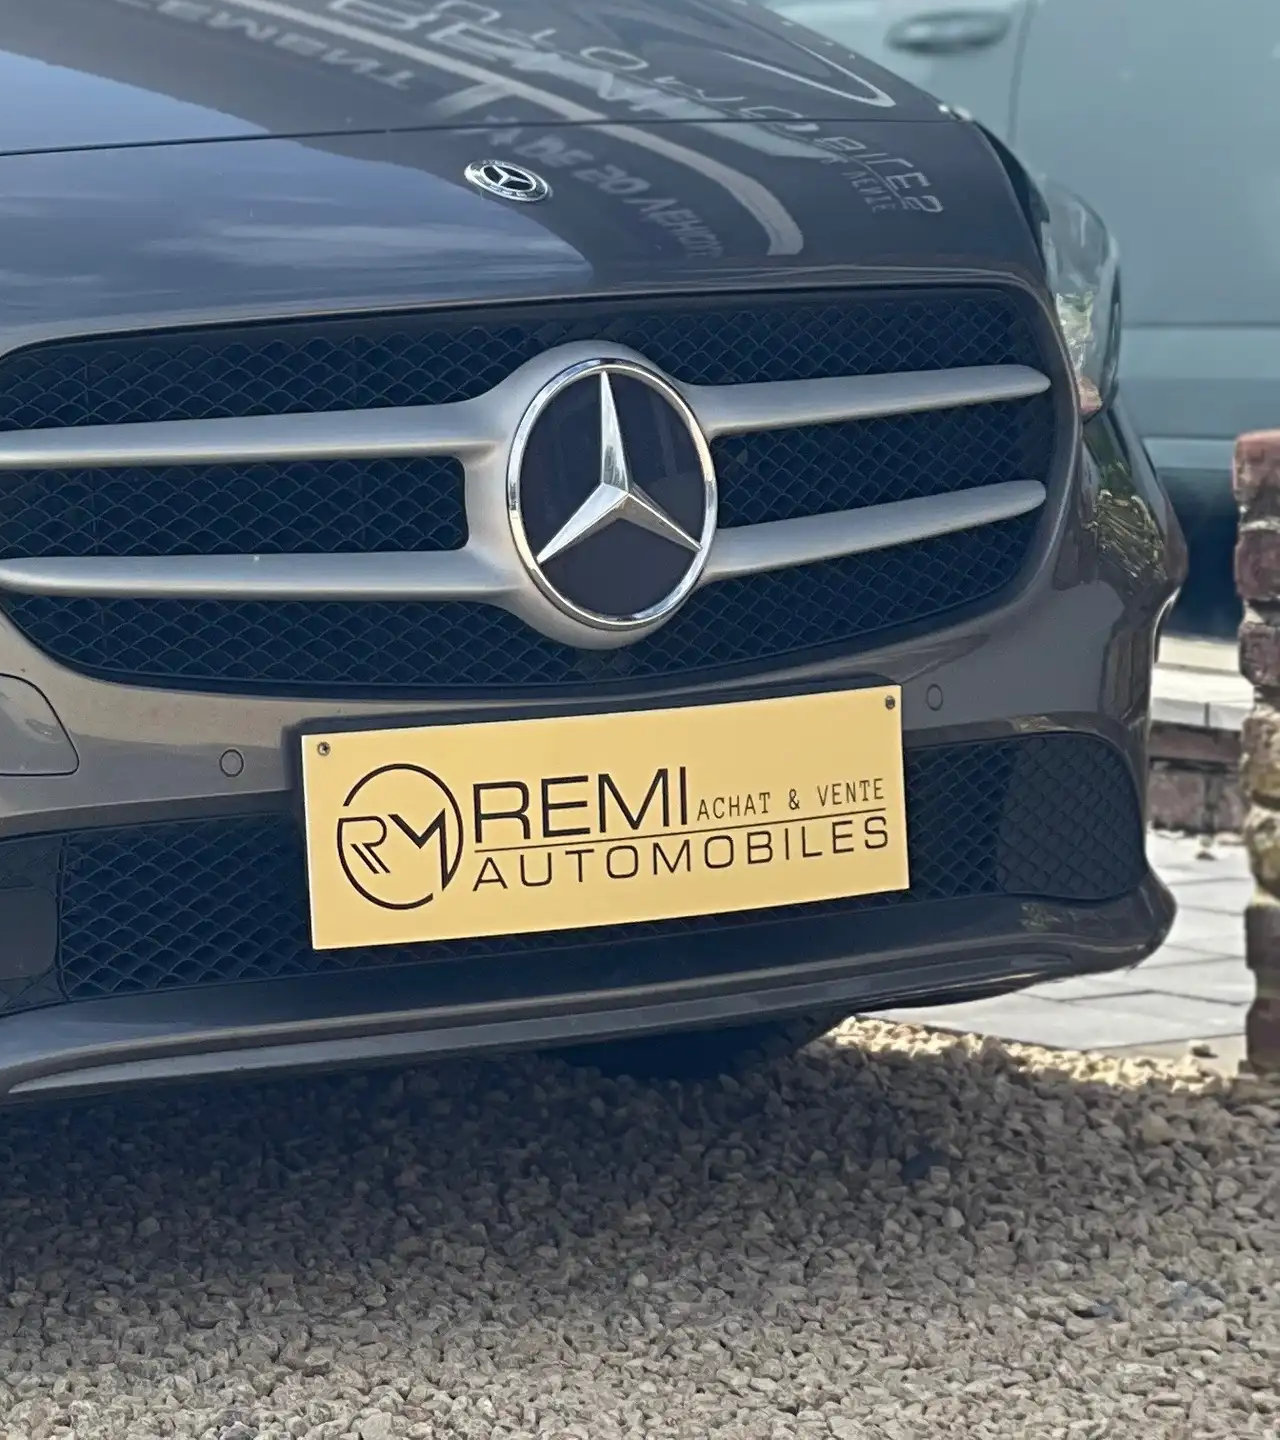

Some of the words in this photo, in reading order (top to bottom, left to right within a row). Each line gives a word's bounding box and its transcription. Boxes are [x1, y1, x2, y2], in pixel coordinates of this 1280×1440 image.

[473, 766, 687, 843] REMI
[697, 791, 772, 821] ACHAT
[787, 789, 801, 808] &
[816, 777, 885, 807] VENTE
[472, 815, 890, 892] AUTOMOBILES
